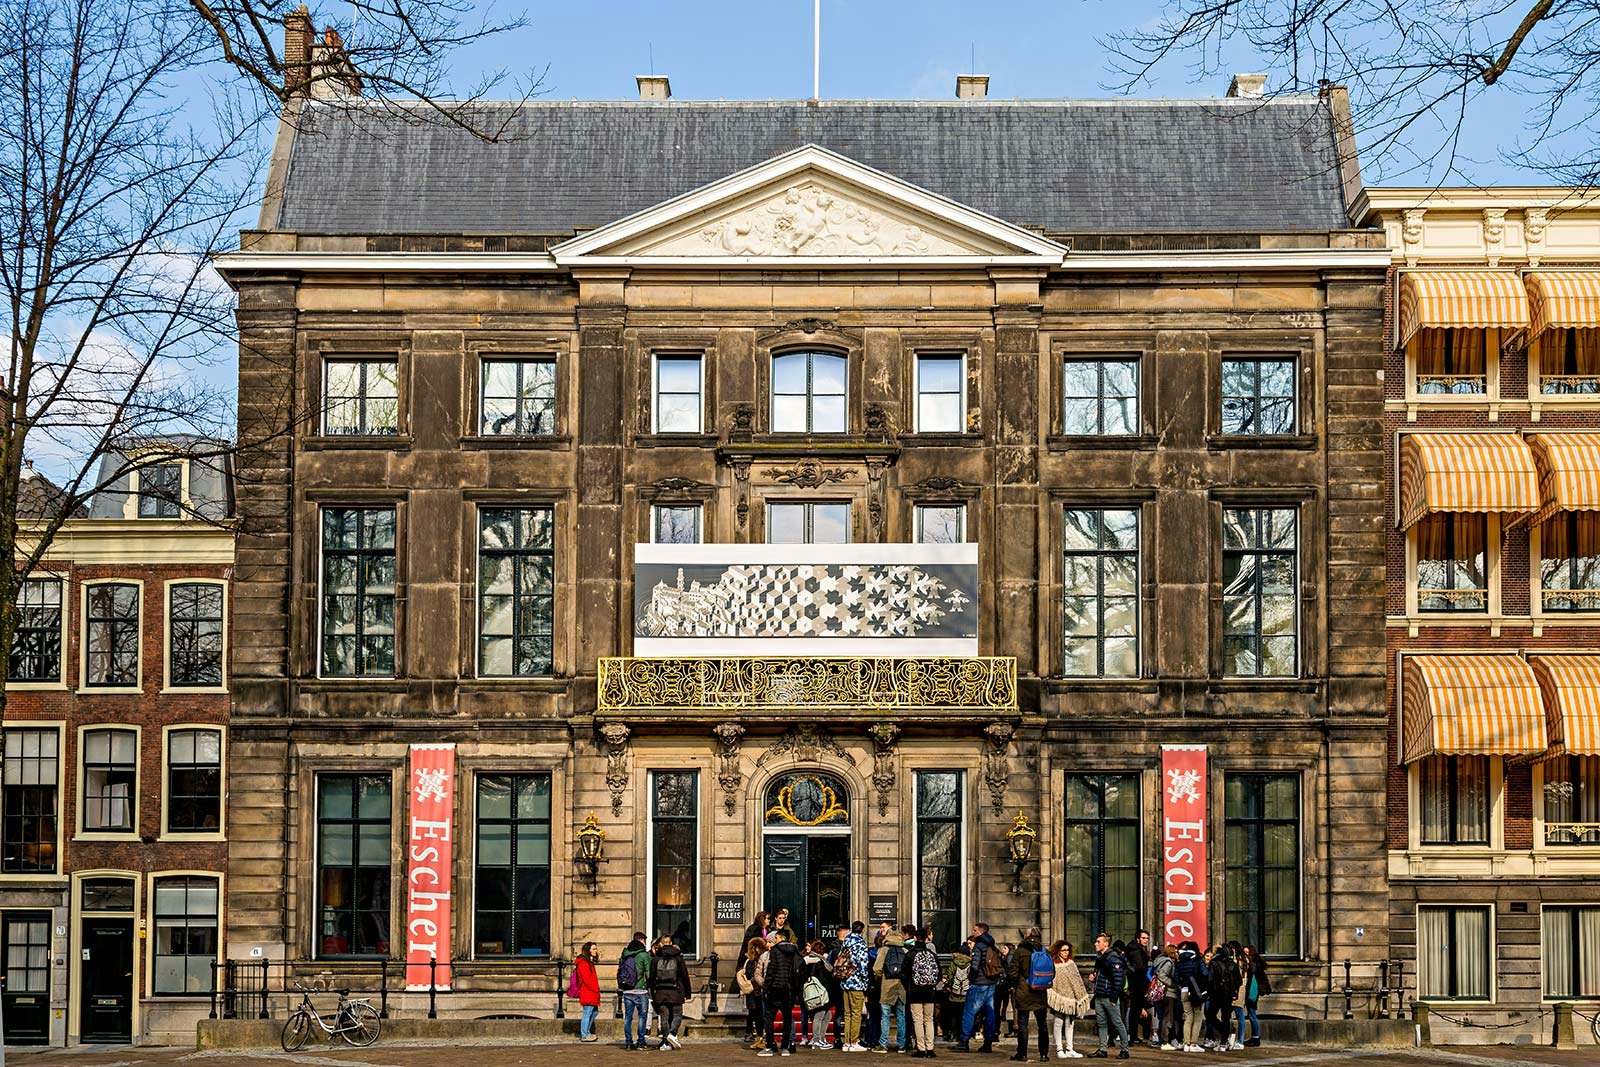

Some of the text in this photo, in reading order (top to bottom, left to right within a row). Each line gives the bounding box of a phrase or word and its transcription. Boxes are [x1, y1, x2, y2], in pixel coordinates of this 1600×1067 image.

[409, 816, 450, 959] Escher
[717, 900, 741, 909] Escher
[1165, 817, 1206, 947] Esche
[821, 929, 838, 938] PAL
